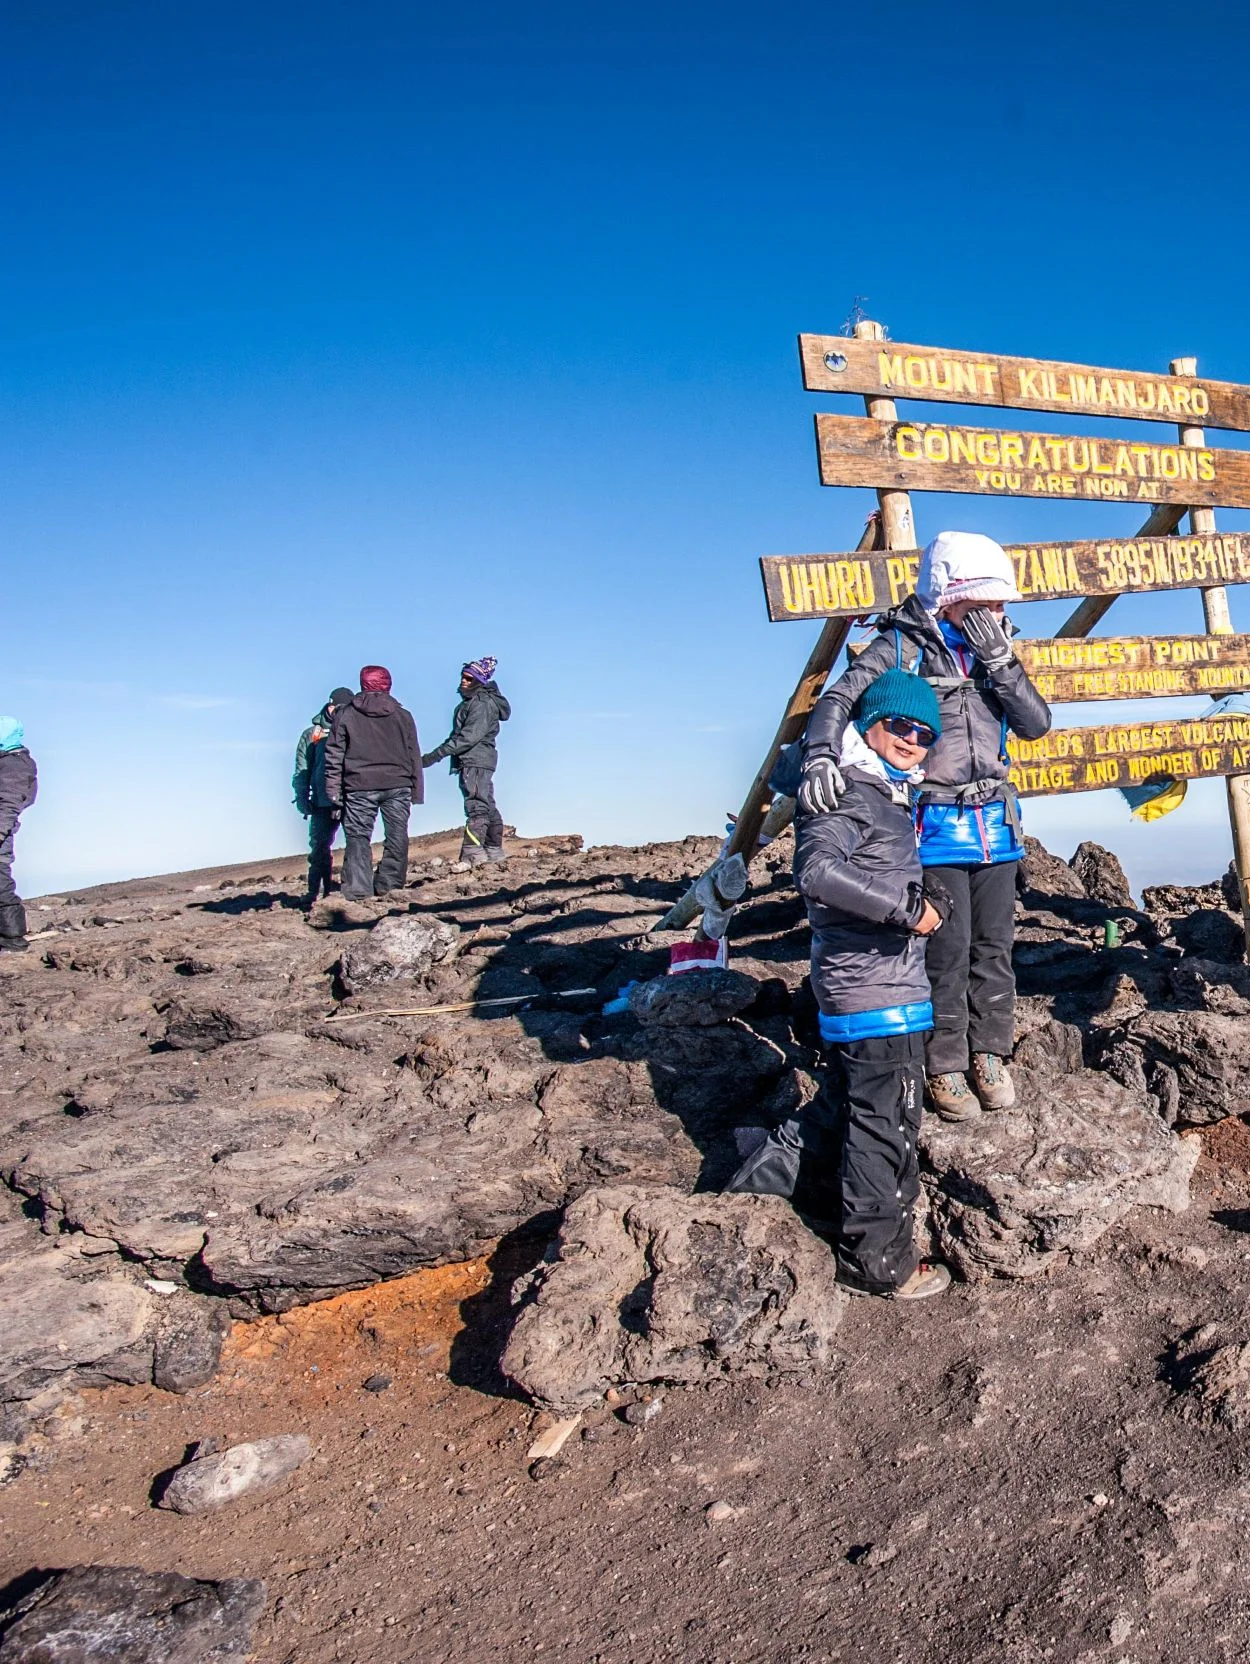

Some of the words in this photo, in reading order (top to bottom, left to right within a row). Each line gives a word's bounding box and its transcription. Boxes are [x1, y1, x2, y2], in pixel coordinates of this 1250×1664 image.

[878, 352, 999, 396] MOUNT
[1018, 367, 1210, 416] KILIMANJARO
[895, 426, 1216, 482] CONGRATULATIONS
[975, 469, 1021, 490] YOU
[1032, 473, 1077, 494] ARE
[1137, 480, 1160, 498] AT
[779, 560, 876, 613] UHURU
[1032, 643, 1141, 667] HIGHEST
[1155, 639, 1221, 665] POINT
[1094, 725, 1172, 755] LARGEST
[1008, 763, 1074, 793] RITAGE
[1085, 758, 1119, 784] AND
[1128, 751, 1193, 780] WONDER
[1202, 747, 1221, 770] OF
